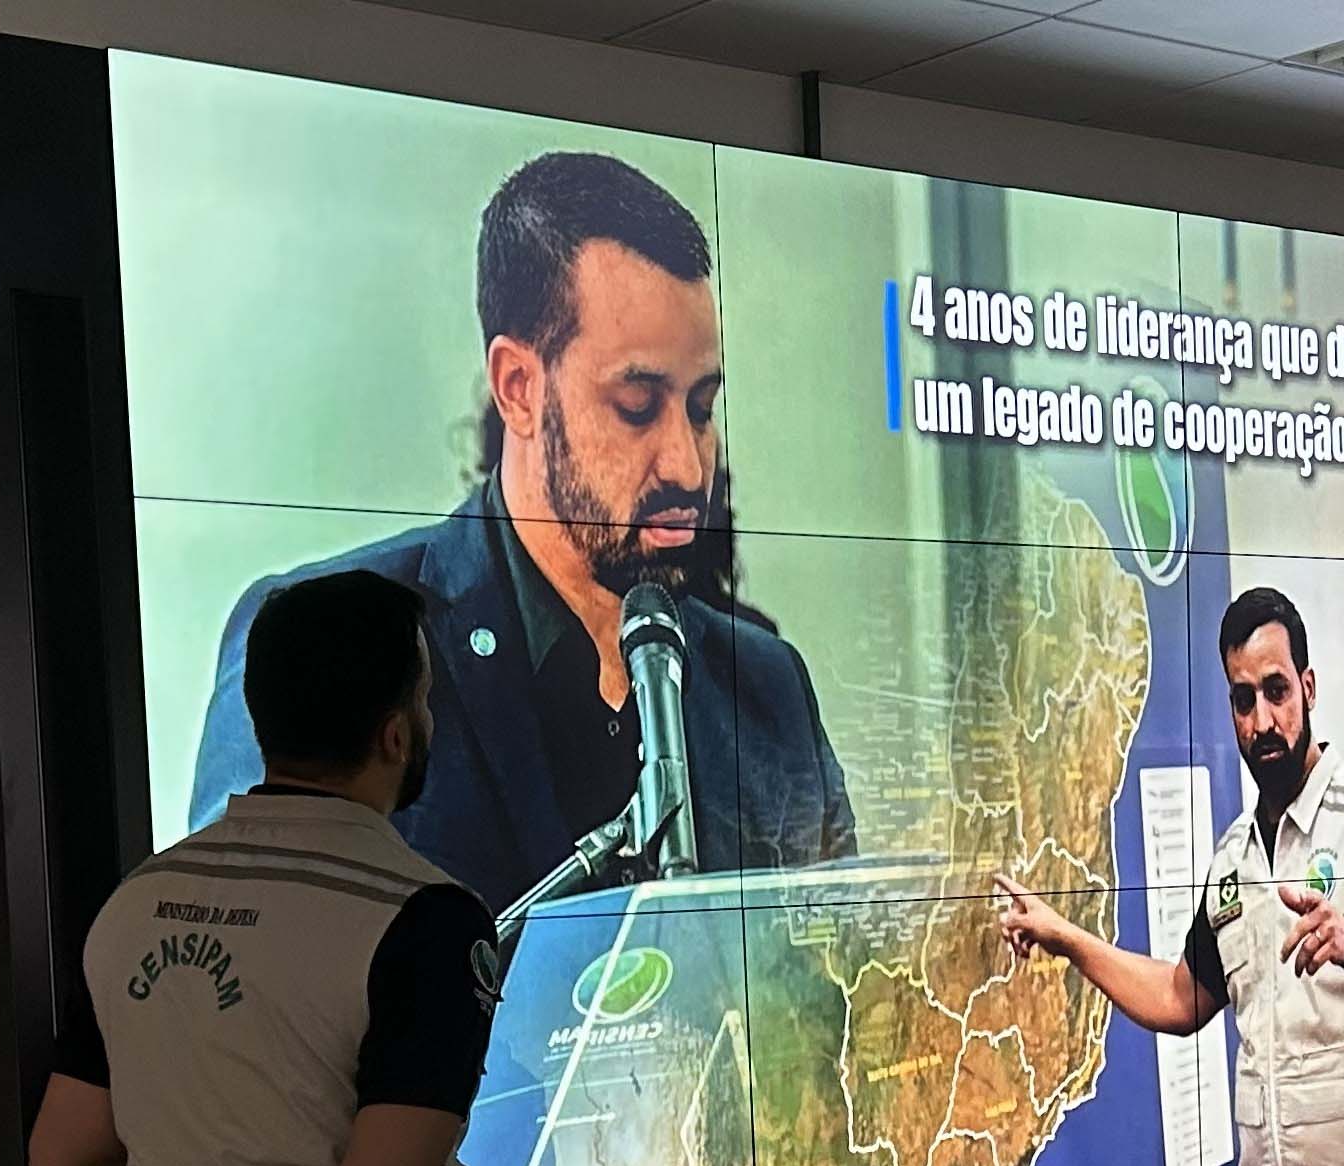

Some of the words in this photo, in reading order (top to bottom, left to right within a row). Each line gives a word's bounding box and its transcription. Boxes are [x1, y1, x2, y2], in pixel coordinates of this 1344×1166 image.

[910, 274, 936, 337] 4
[944, 286, 1035, 347] anos
[1043, 291, 1088, 352] de
[1096, 295, 1254, 385] liderança
[1261, 323, 1319, 380] que
[914, 378, 974, 435] um
[982, 376, 1103, 446] legado
[1112, 389, 1155, 448] de
[127, 932, 244, 1011] CENSIPAM
